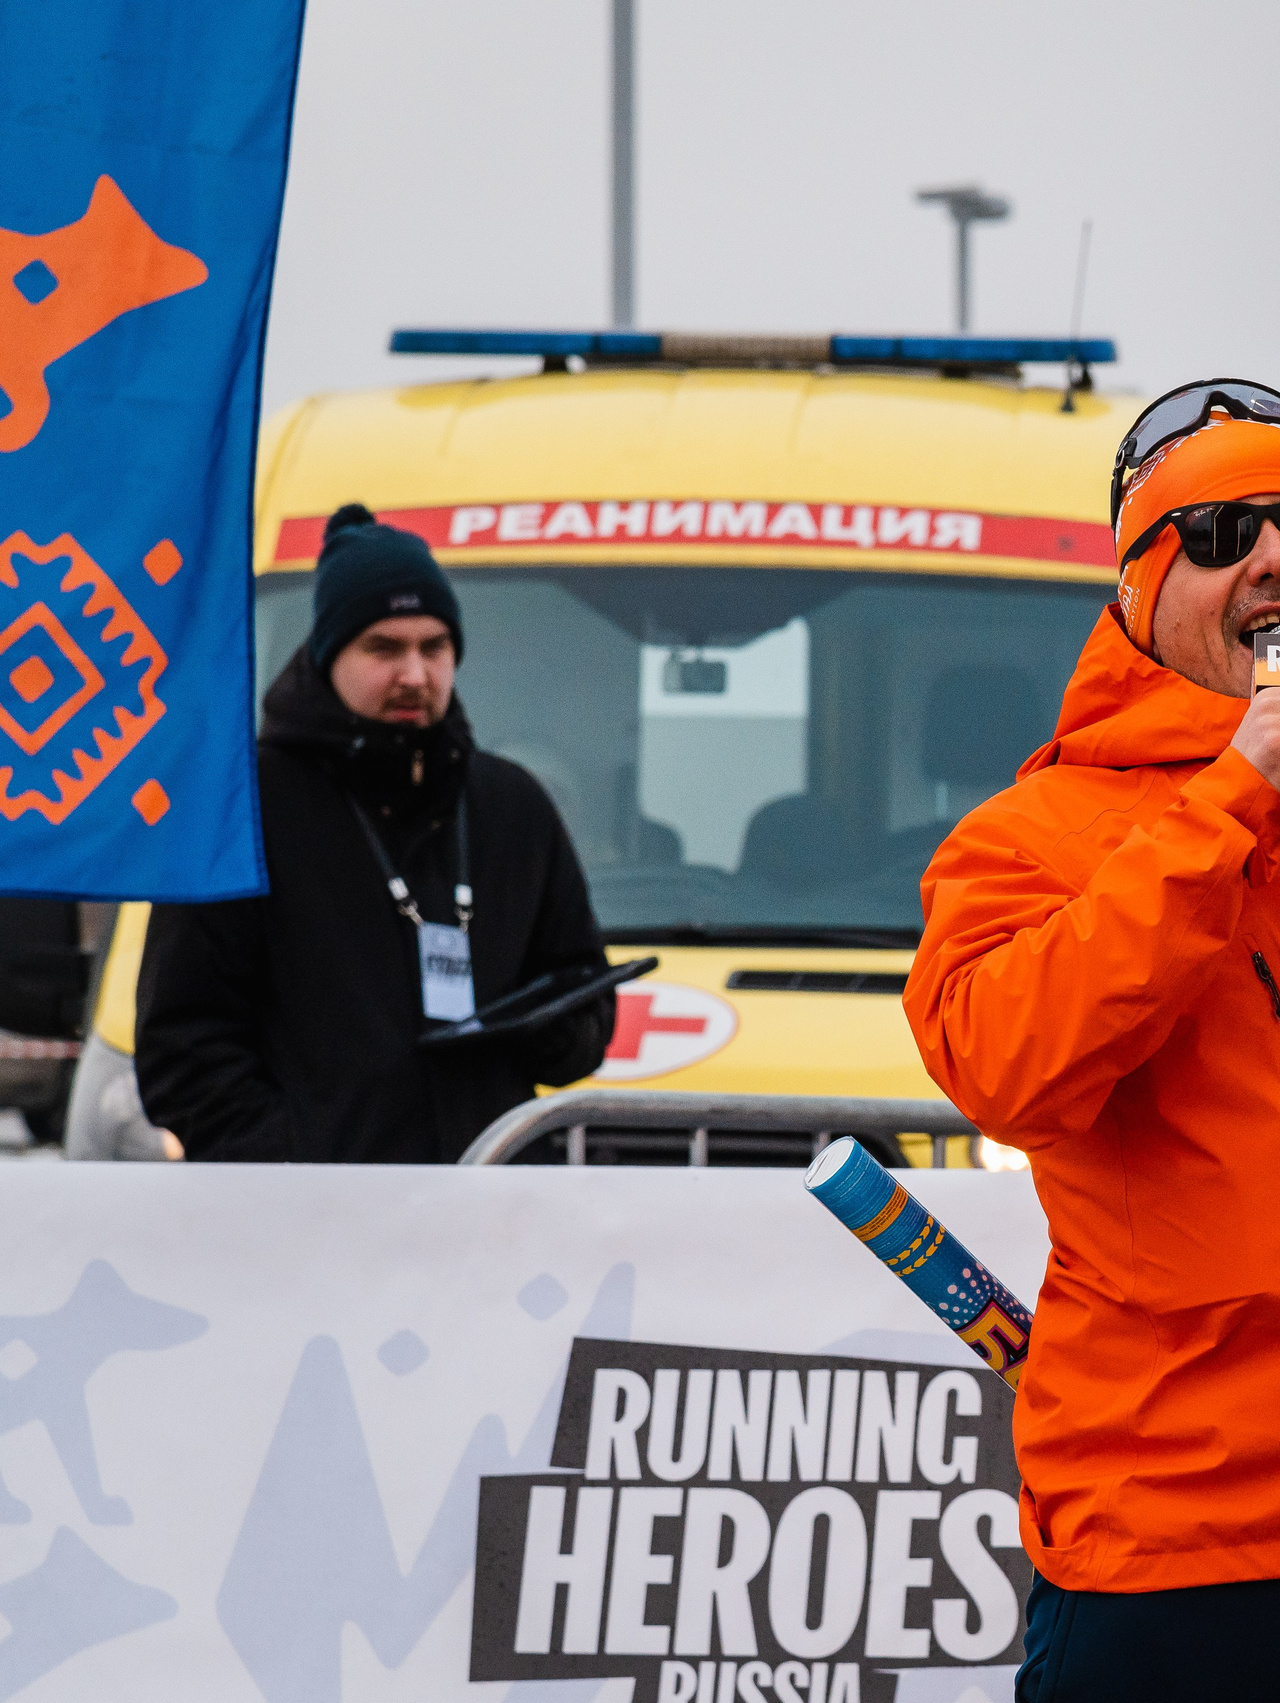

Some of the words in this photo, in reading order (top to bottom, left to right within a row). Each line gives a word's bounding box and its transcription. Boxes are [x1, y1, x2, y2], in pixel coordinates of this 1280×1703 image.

[449, 501, 983, 552] РЕАНИМАЦИЯ
[585, 1367, 983, 1485] RUNNING
[514, 1485, 1022, 1662] HEROES
[657, 1660, 861, 1703] RUSSIA
